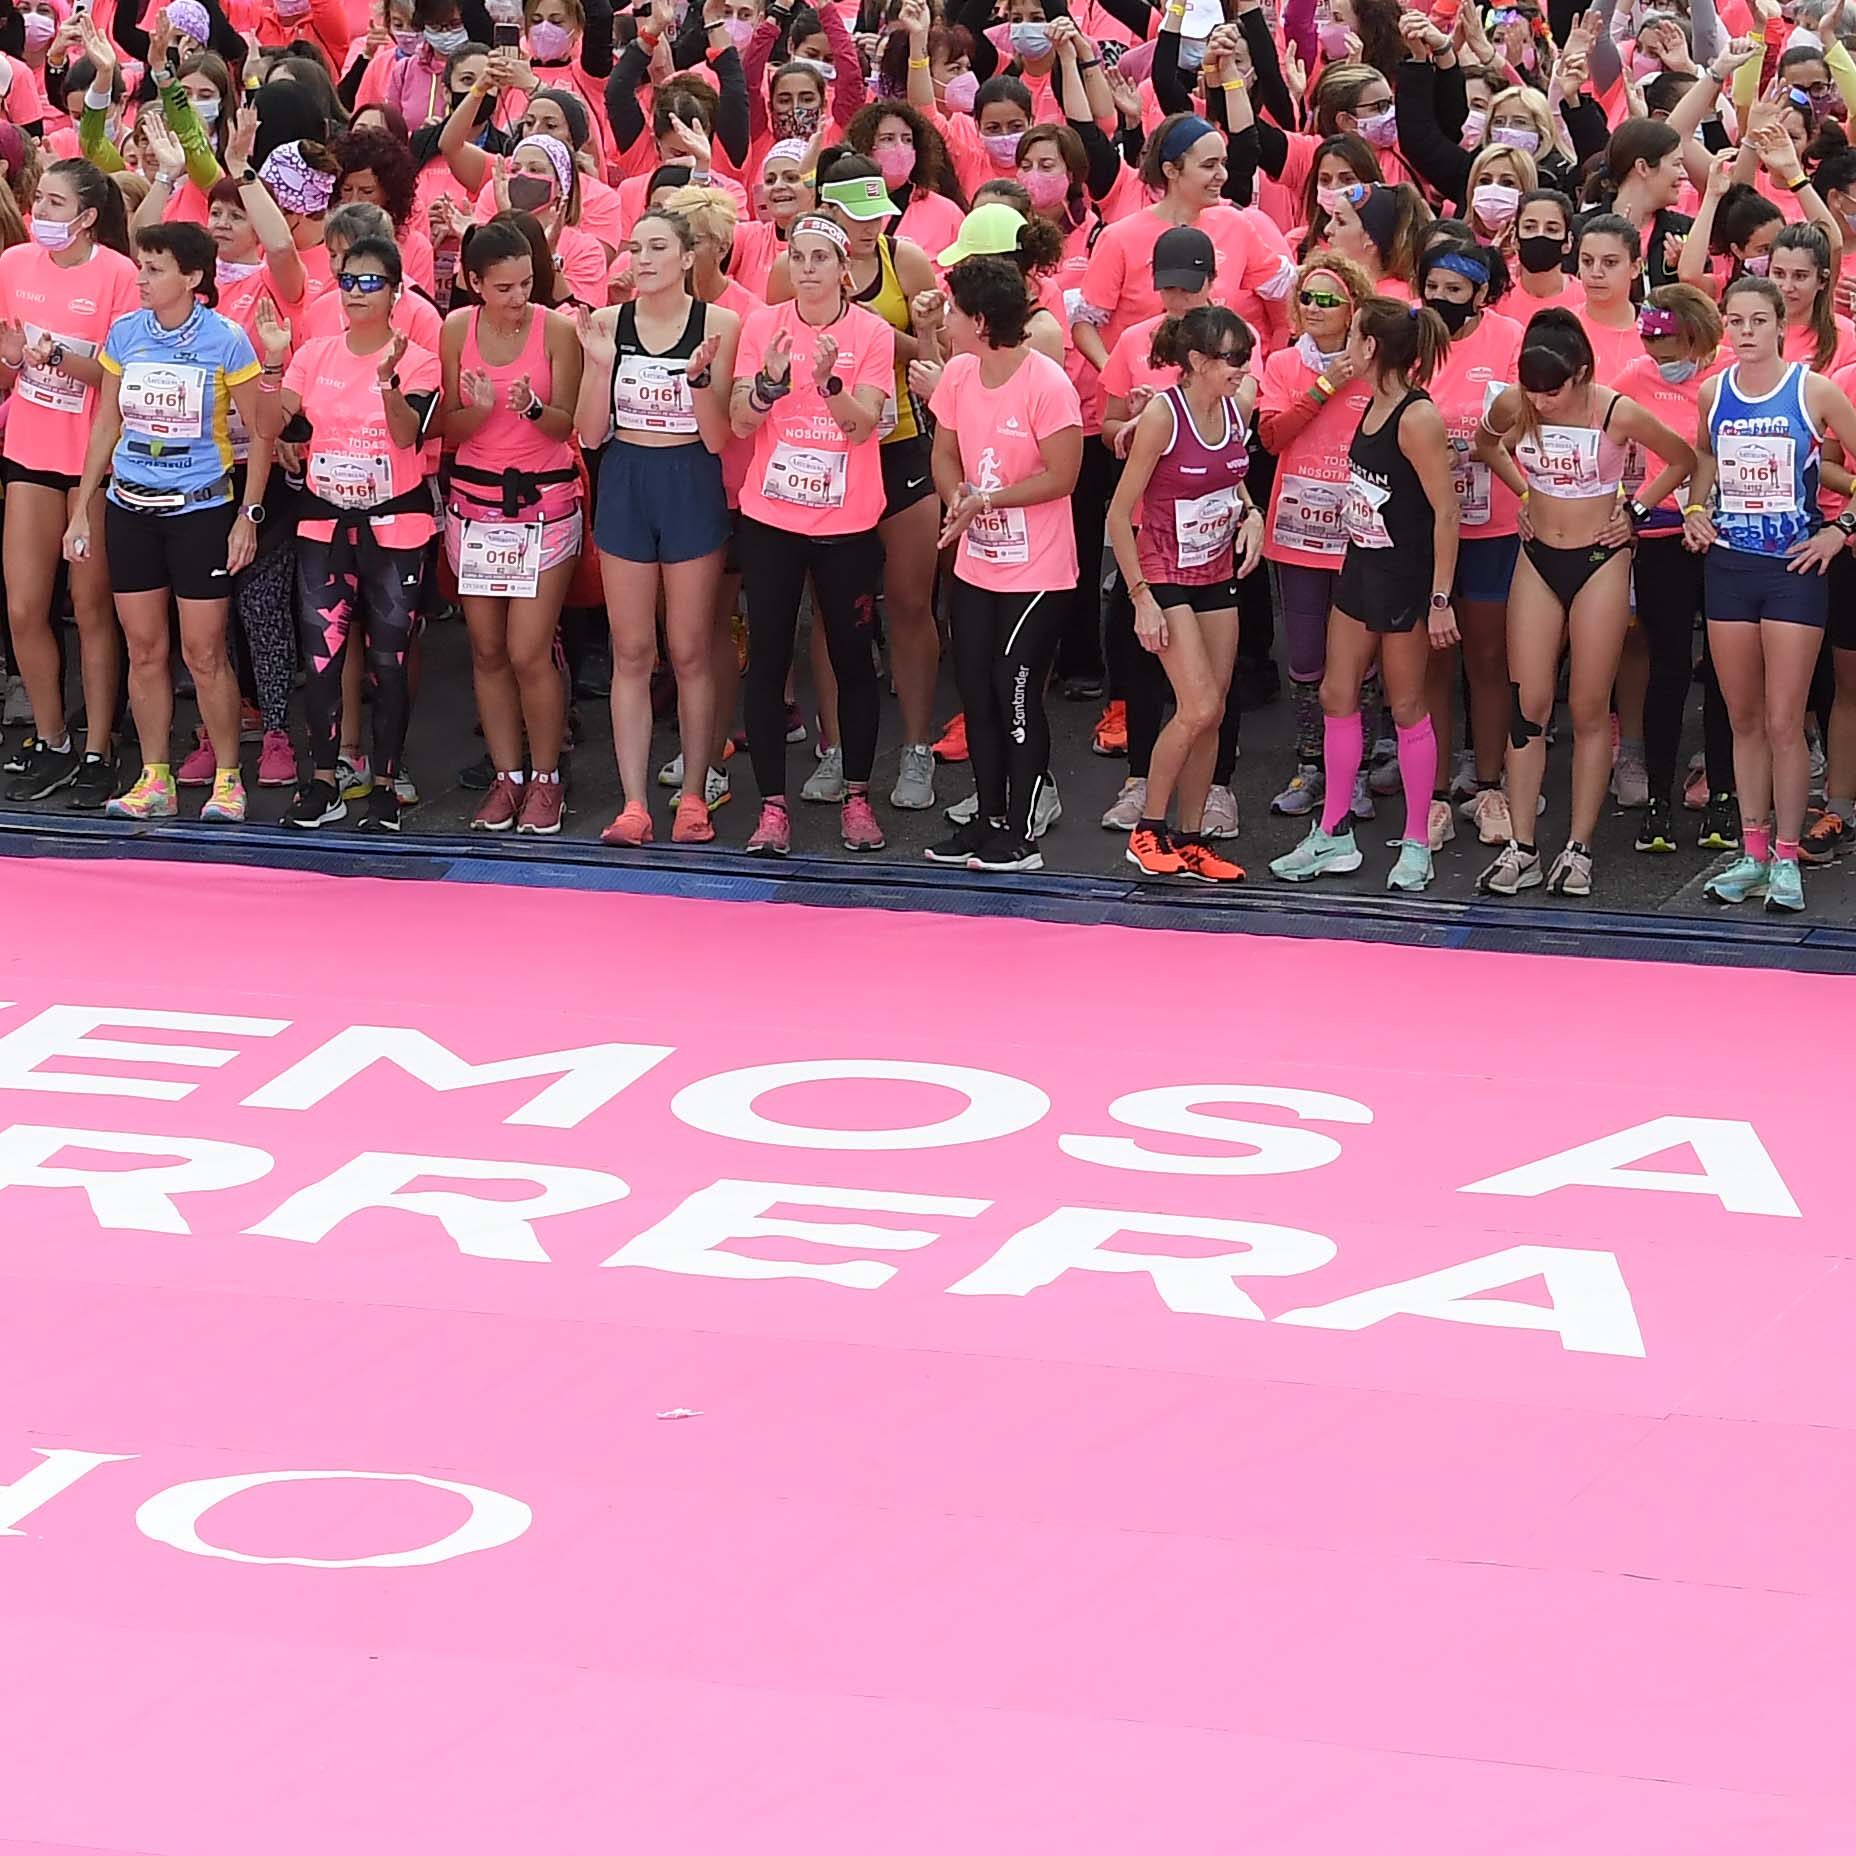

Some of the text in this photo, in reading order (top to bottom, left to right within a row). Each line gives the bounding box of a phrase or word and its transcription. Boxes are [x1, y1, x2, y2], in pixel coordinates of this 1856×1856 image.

[144, 392, 177, 409] 016
[639, 386, 674, 402] 016
[785, 428, 845, 442] NOSOTRA
[1539, 454, 1573, 472] 016
[1739, 466, 1769, 482] 016
[787, 473, 821, 493] 016
[334, 485, 369, 499] 016
[1299, 507, 1334, 525] 016
[486, 550, 518, 566] 016
[1453, 1113, 1804, 1220] A
